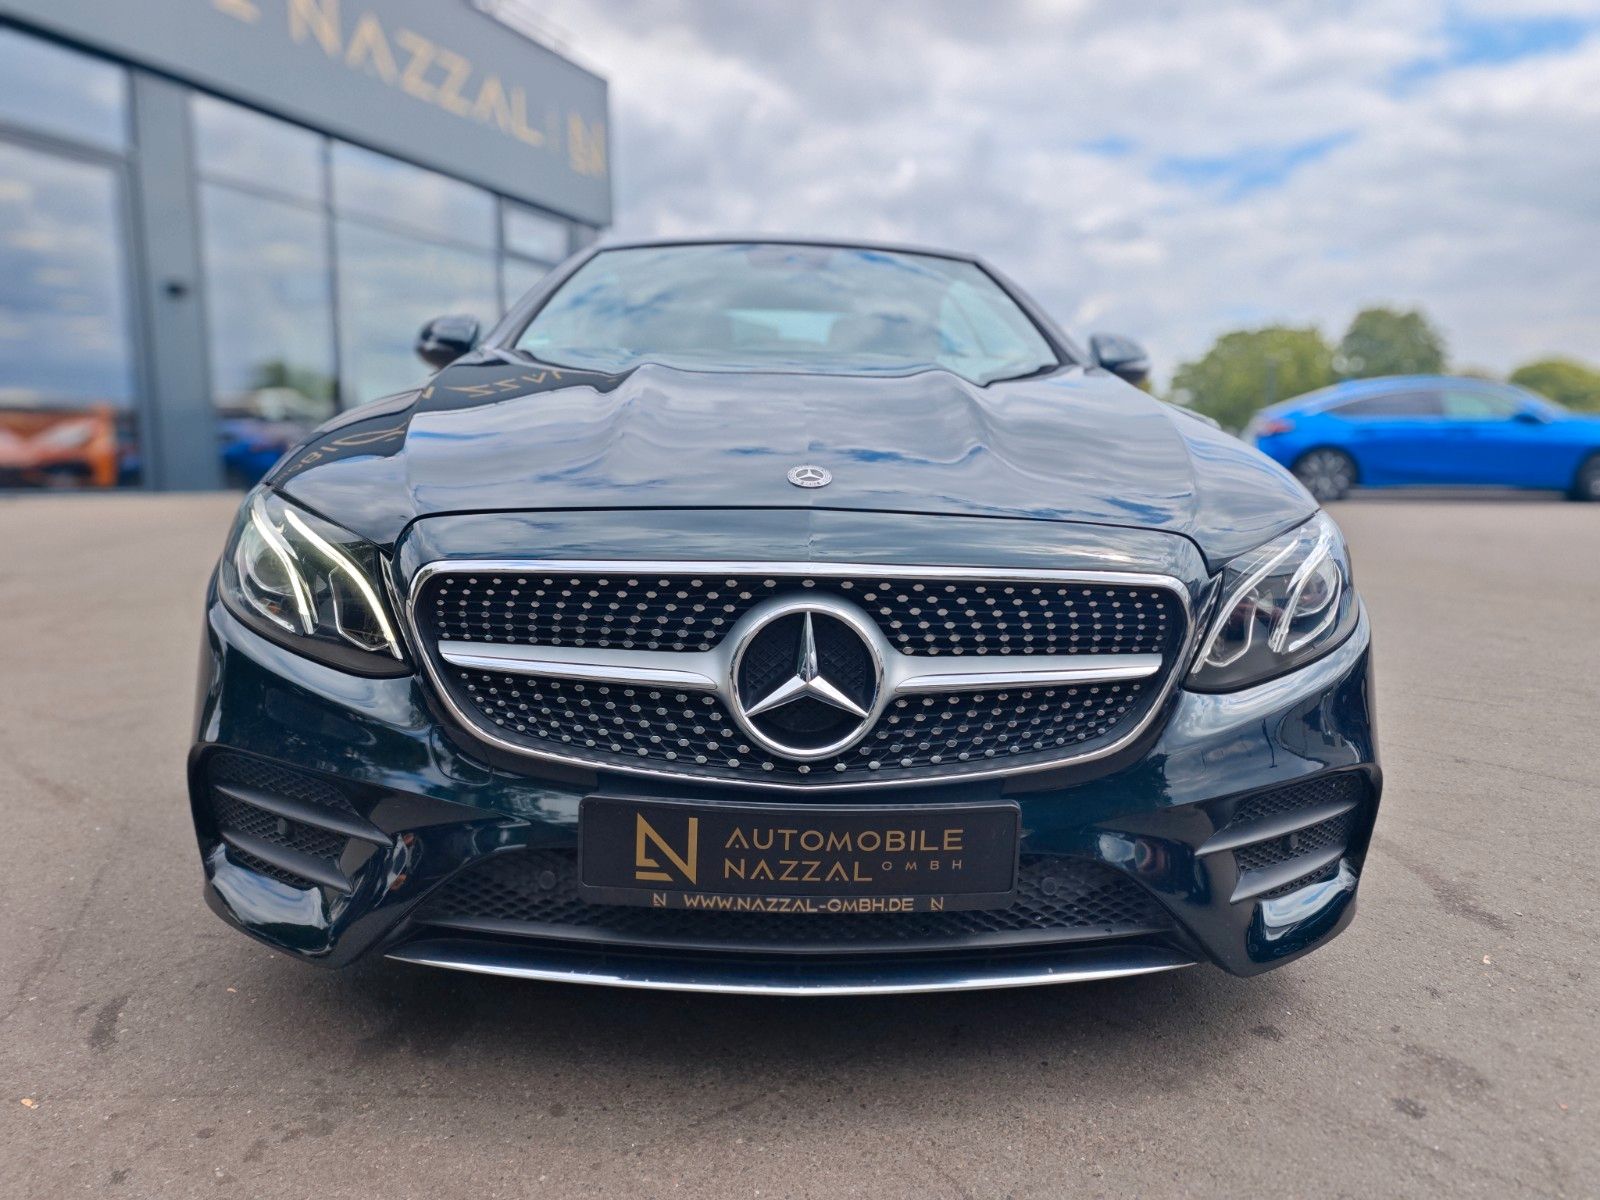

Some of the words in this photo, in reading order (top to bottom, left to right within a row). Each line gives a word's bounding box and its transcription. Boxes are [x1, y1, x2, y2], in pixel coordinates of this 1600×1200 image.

[288, 0, 543, 147] NAZZAL
[724, 826, 964, 851] AUTOMOBILE
[724, 858, 873, 882] NAZZAL
[683, 894, 914, 912] WWW.NAZZAL-GMBH.DE
